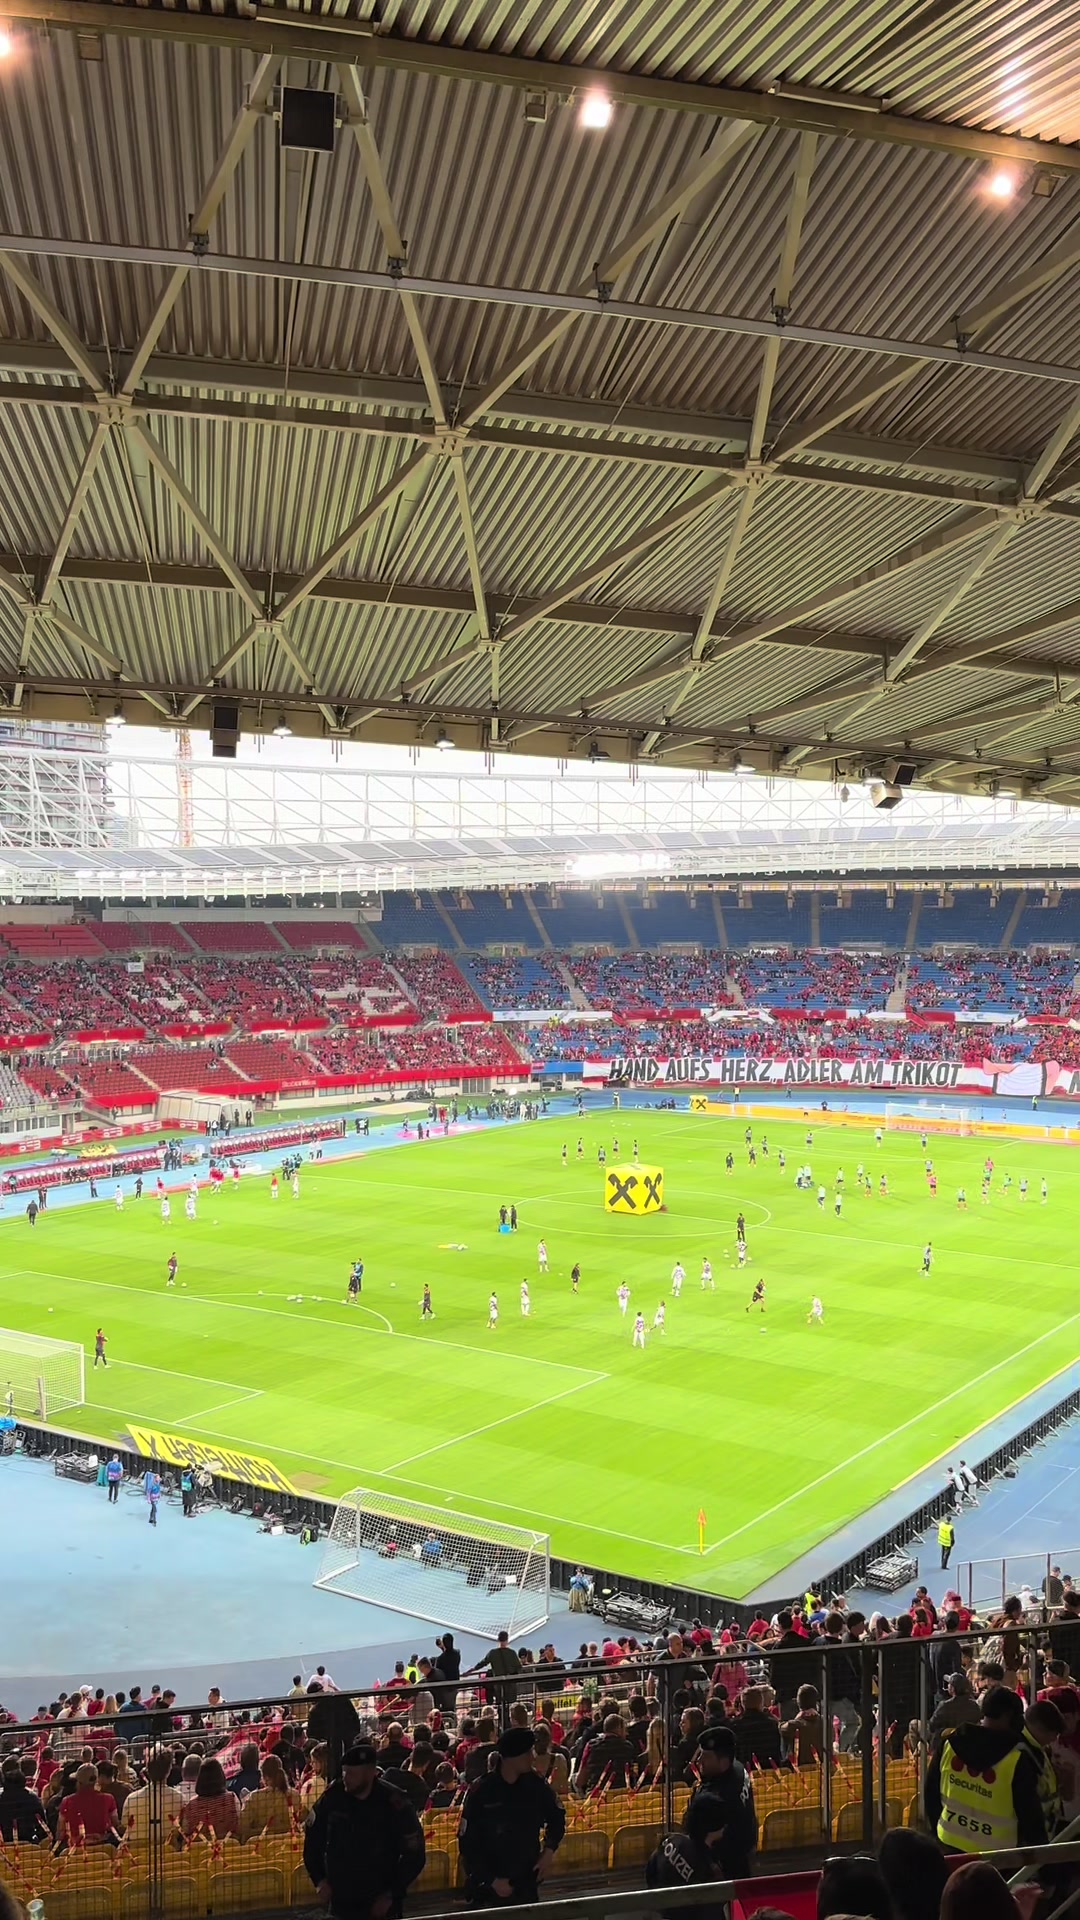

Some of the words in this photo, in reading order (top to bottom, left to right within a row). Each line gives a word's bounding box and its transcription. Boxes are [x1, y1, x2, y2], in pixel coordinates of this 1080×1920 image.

[608, 1058, 660, 1082] HAND
[664, 1057, 713, 1082] AUFS
[784, 1058, 843, 1083] ADLER
[850, 1059, 884, 1084] AM
[890, 1060, 963, 1087] TRIKOT
[949, 1773, 993, 1799] Securitas
[946, 1809, 993, 1836] 7658
